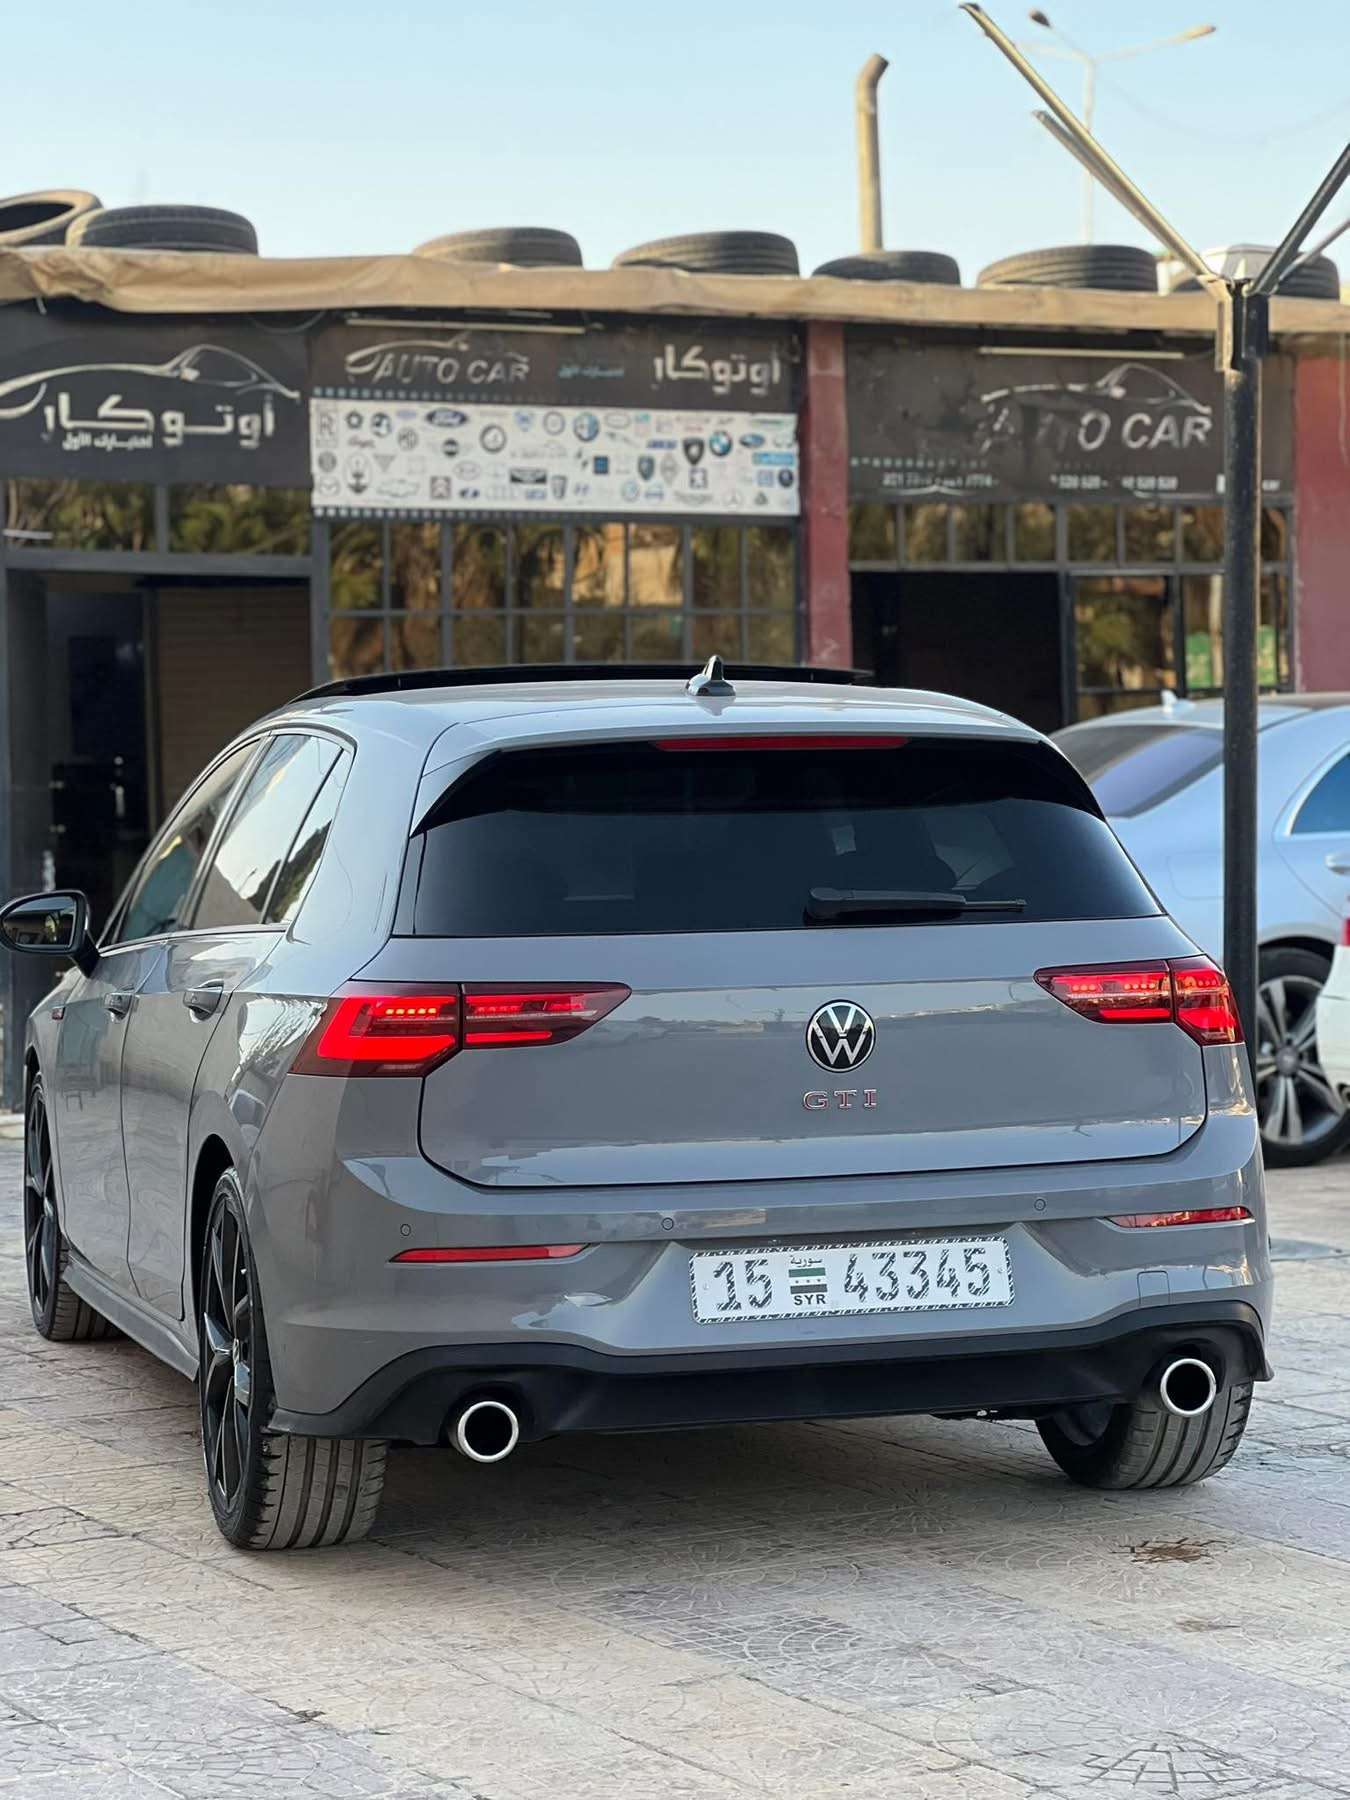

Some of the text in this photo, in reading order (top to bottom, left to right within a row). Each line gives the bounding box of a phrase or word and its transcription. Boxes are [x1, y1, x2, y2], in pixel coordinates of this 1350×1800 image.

[372, 352, 460, 384] AUTO
[467, 359, 531, 384] CAR
[1121, 413, 1213, 448] CAR
[803, 1089, 877, 1110] GTI
[712, 1248, 988, 1311] 15 43345
[794, 1294, 826, 1306] SYR
